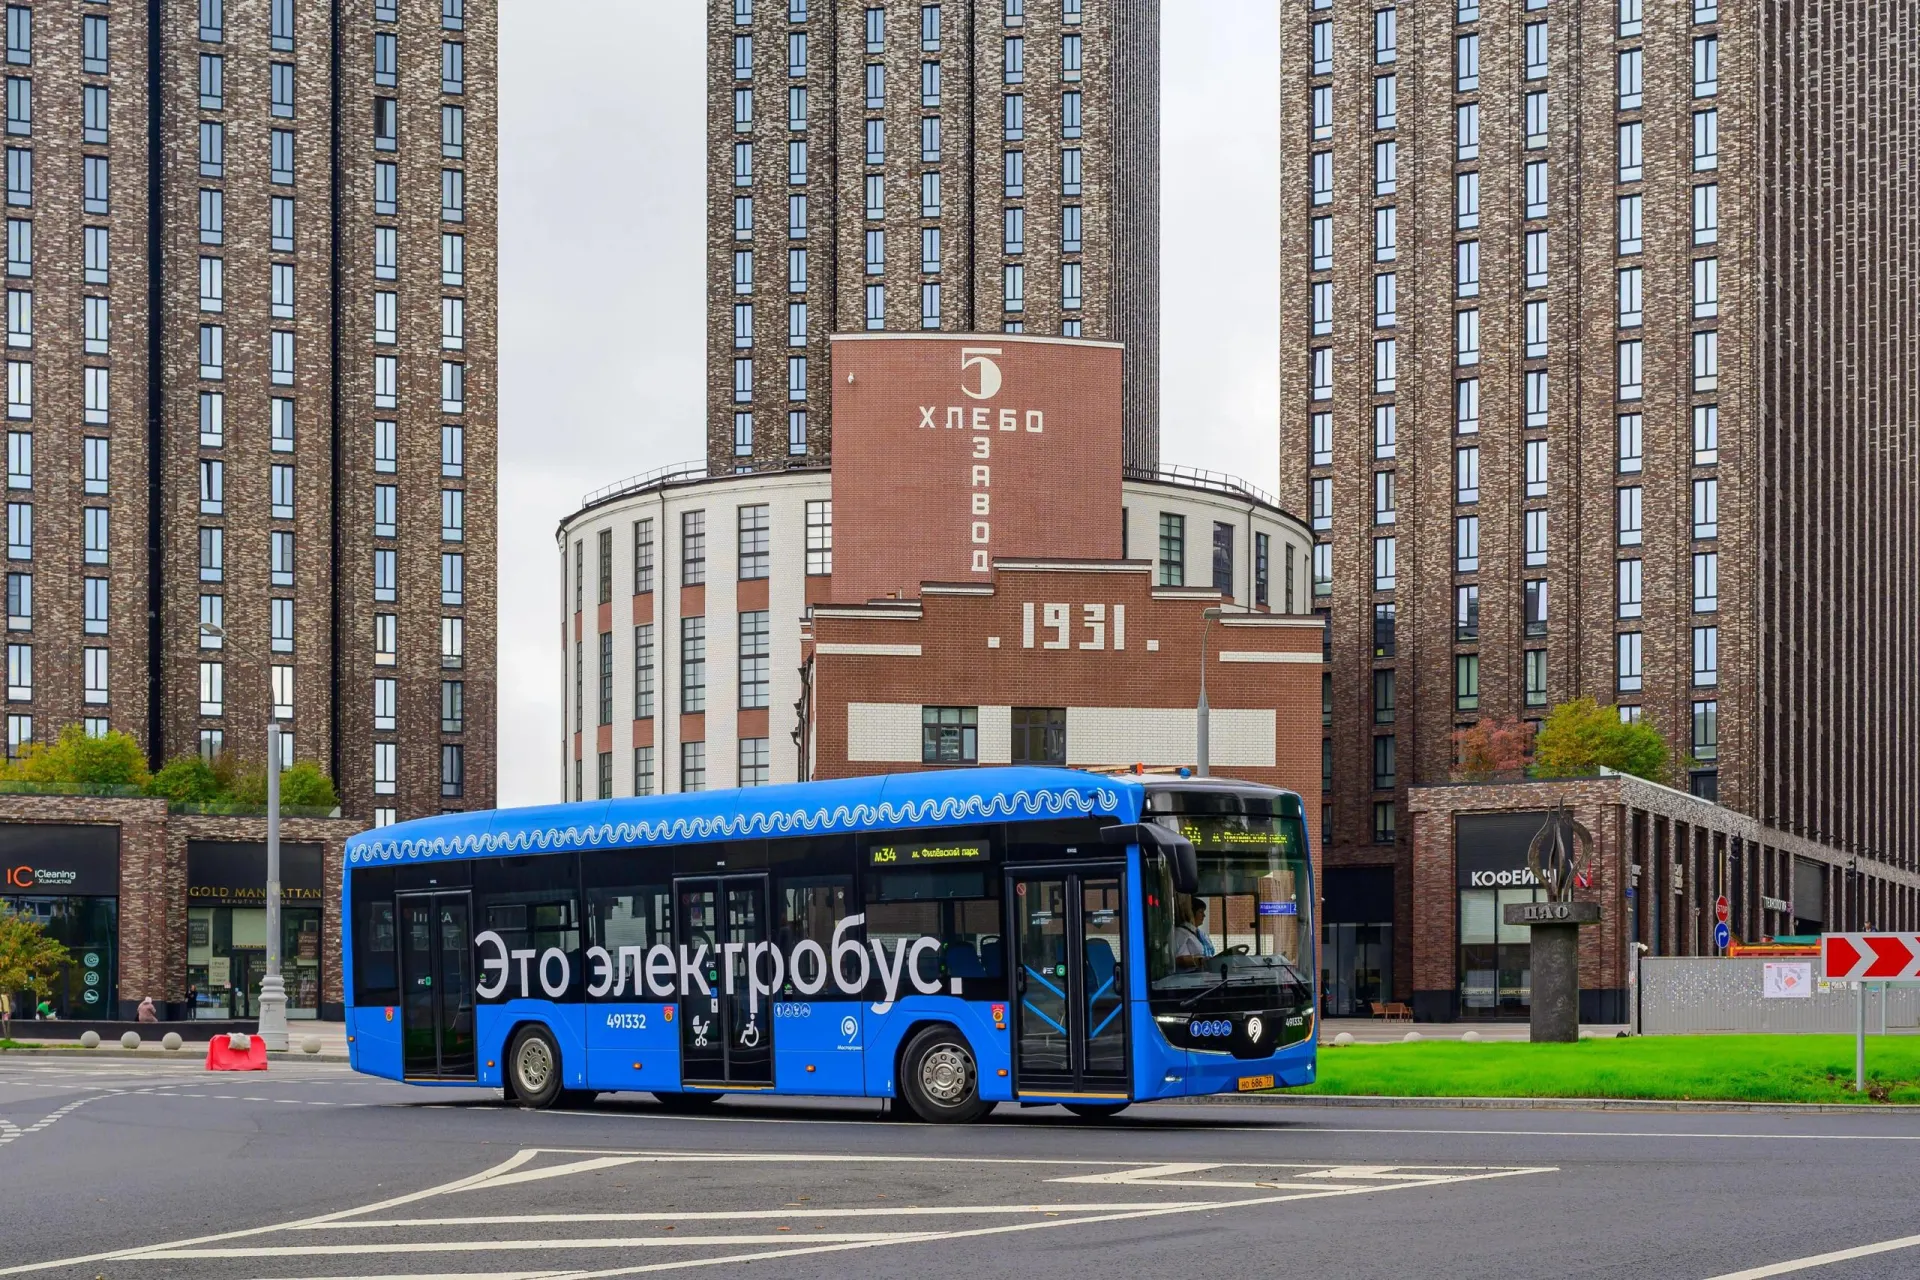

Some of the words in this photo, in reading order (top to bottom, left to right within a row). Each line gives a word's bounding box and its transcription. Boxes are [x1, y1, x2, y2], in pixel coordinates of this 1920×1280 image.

[961, 347, 1003, 400] 5
[918, 406, 1044, 433] ХЛЕБО
[971, 436, 991, 573] ЗАВОД
[1022, 602, 1126, 651] 1931
[921, 847, 961, 858] Филёвский
[961, 848, 980, 858] парк
[189, 886, 230, 897] GOLD
[234, 887, 322, 899] MANATTAN
[1524, 905, 1570, 920] ЦАО
[474, 929, 571, 999] Это
[586, 912, 963, 1015] электробус.
[606, 1013, 647, 1029] 491332
[1285, 1016, 1304, 1027] 491332
[1251, 1077, 1263, 1088] 686
